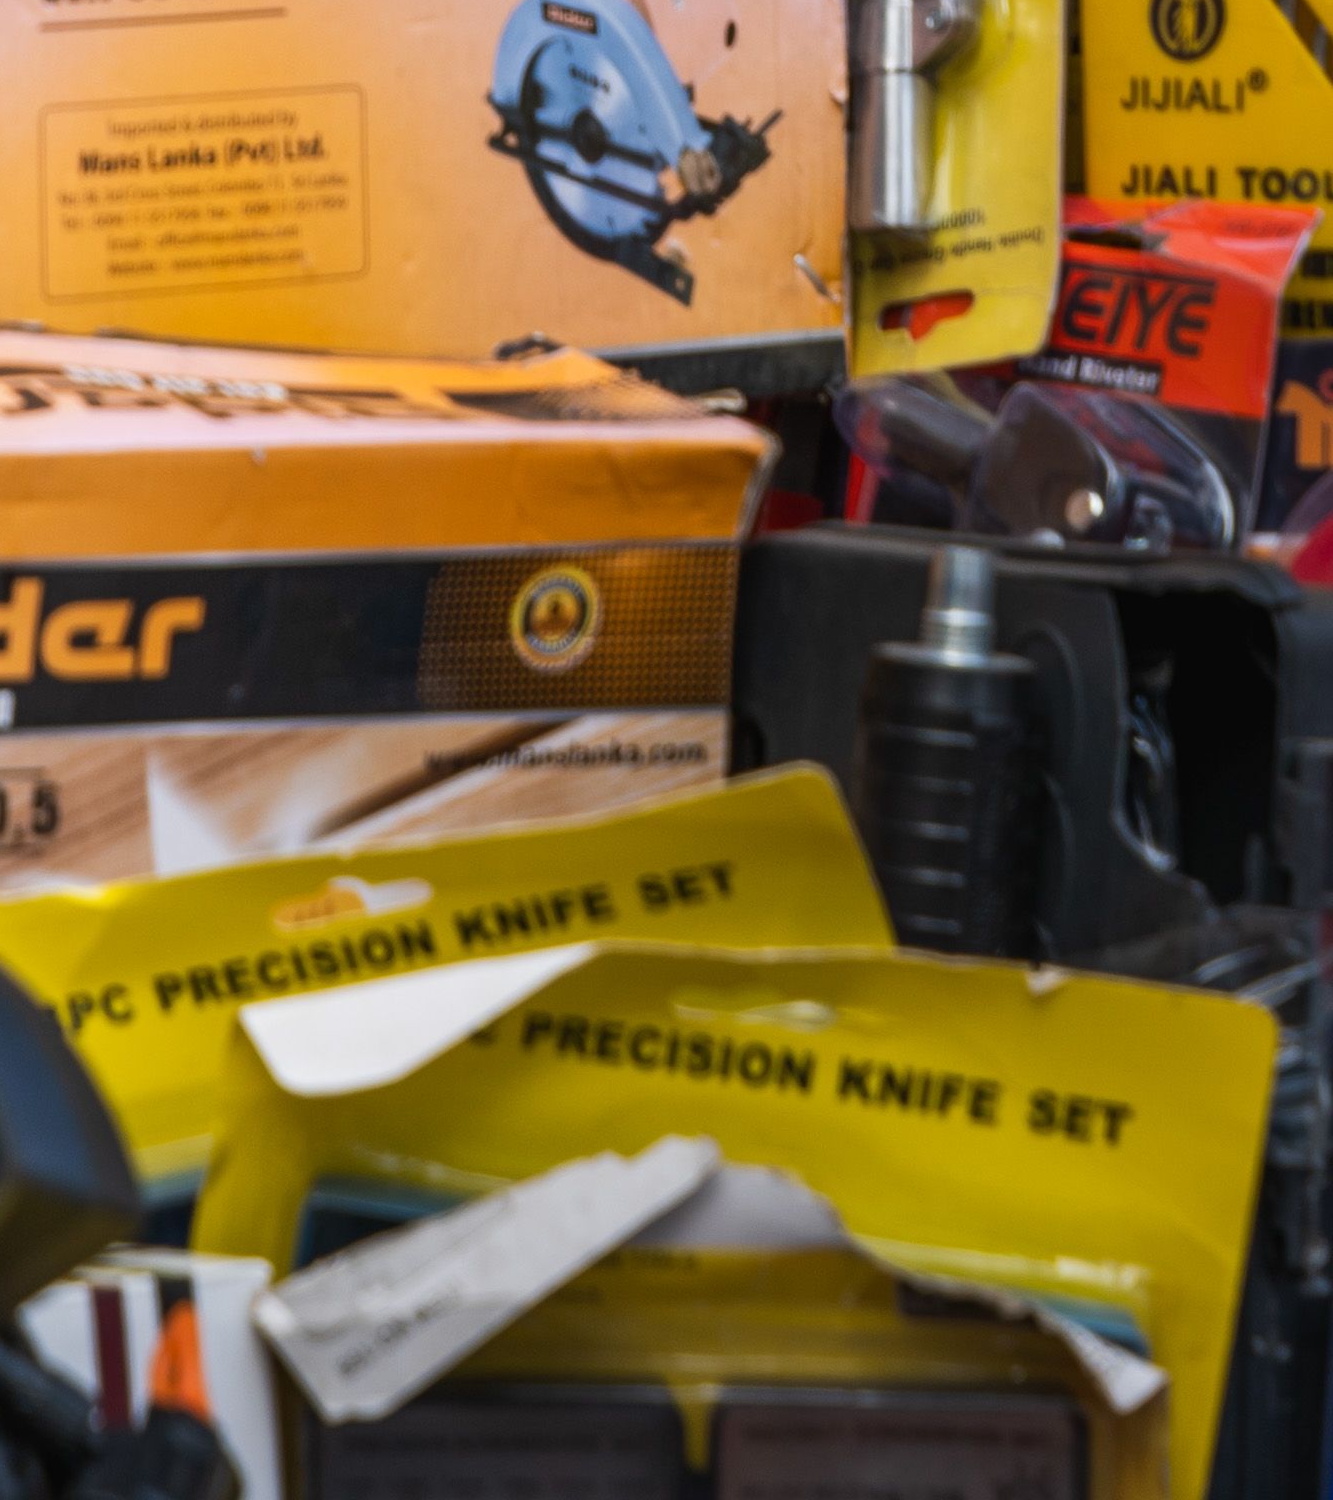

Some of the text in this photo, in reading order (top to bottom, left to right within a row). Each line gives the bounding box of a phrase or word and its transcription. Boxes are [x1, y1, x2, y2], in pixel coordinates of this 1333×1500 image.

[1120, 75, 1245, 114] JIJIALI
[1121, 164, 1218, 198] JIALI
[1061, 263, 1218, 359] EIYE
[151, 859, 740, 1013] PRECISION KNIFE SET
[521, 1008, 1137, 1150] PRECISION KNIFE SET
